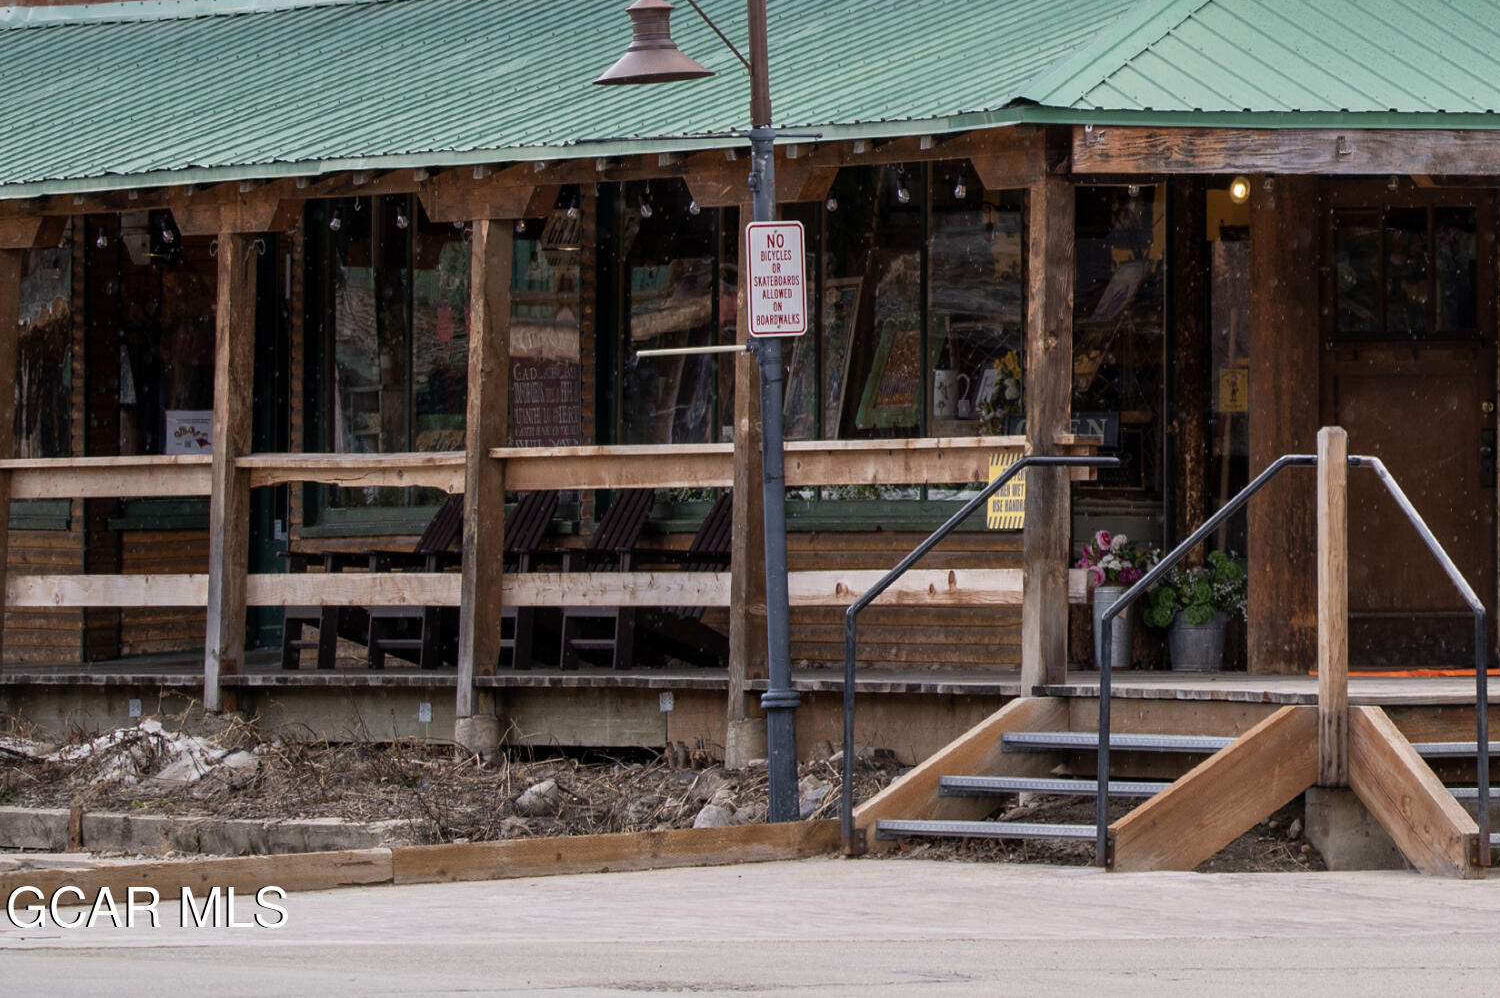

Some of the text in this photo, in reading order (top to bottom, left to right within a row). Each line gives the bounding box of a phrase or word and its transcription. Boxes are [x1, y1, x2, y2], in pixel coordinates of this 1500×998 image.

[767, 233, 785, 248] NO
[760, 249, 792, 262] BICYCLES
[772, 263, 781, 274] OR
[753, 275, 800, 287] SKATEBOARDS
[762, 288, 793, 300] ALLOWED
[773, 302, 783, 312] ON
[756, 313, 801, 326] BOARDWALKS
[1012, 483, 1024, 497] WET
[992, 499, 1003, 513] USE
